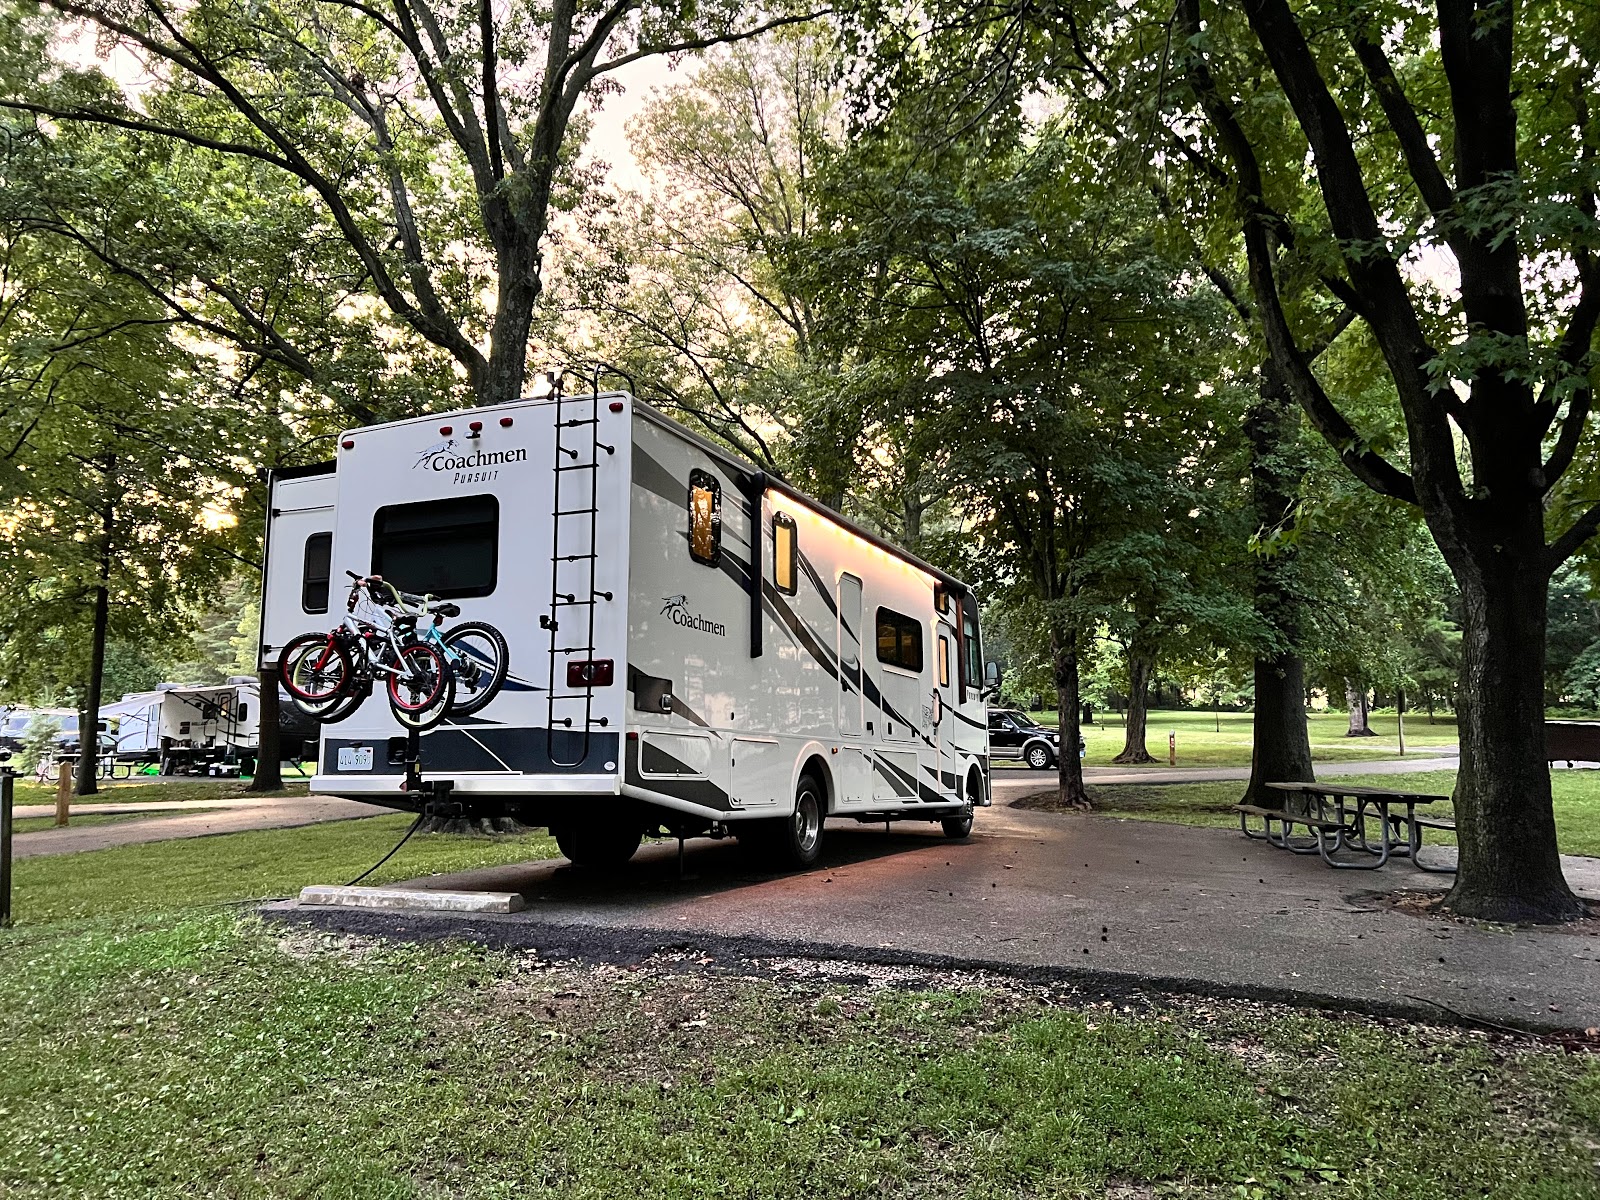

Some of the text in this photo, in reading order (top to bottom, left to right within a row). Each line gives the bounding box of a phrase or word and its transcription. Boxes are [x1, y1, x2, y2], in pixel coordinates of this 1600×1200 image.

[432, 448, 527, 471] Coachmen
[453, 470, 498, 484] PURSUIT
[672, 608, 725, 636] Coachmen
